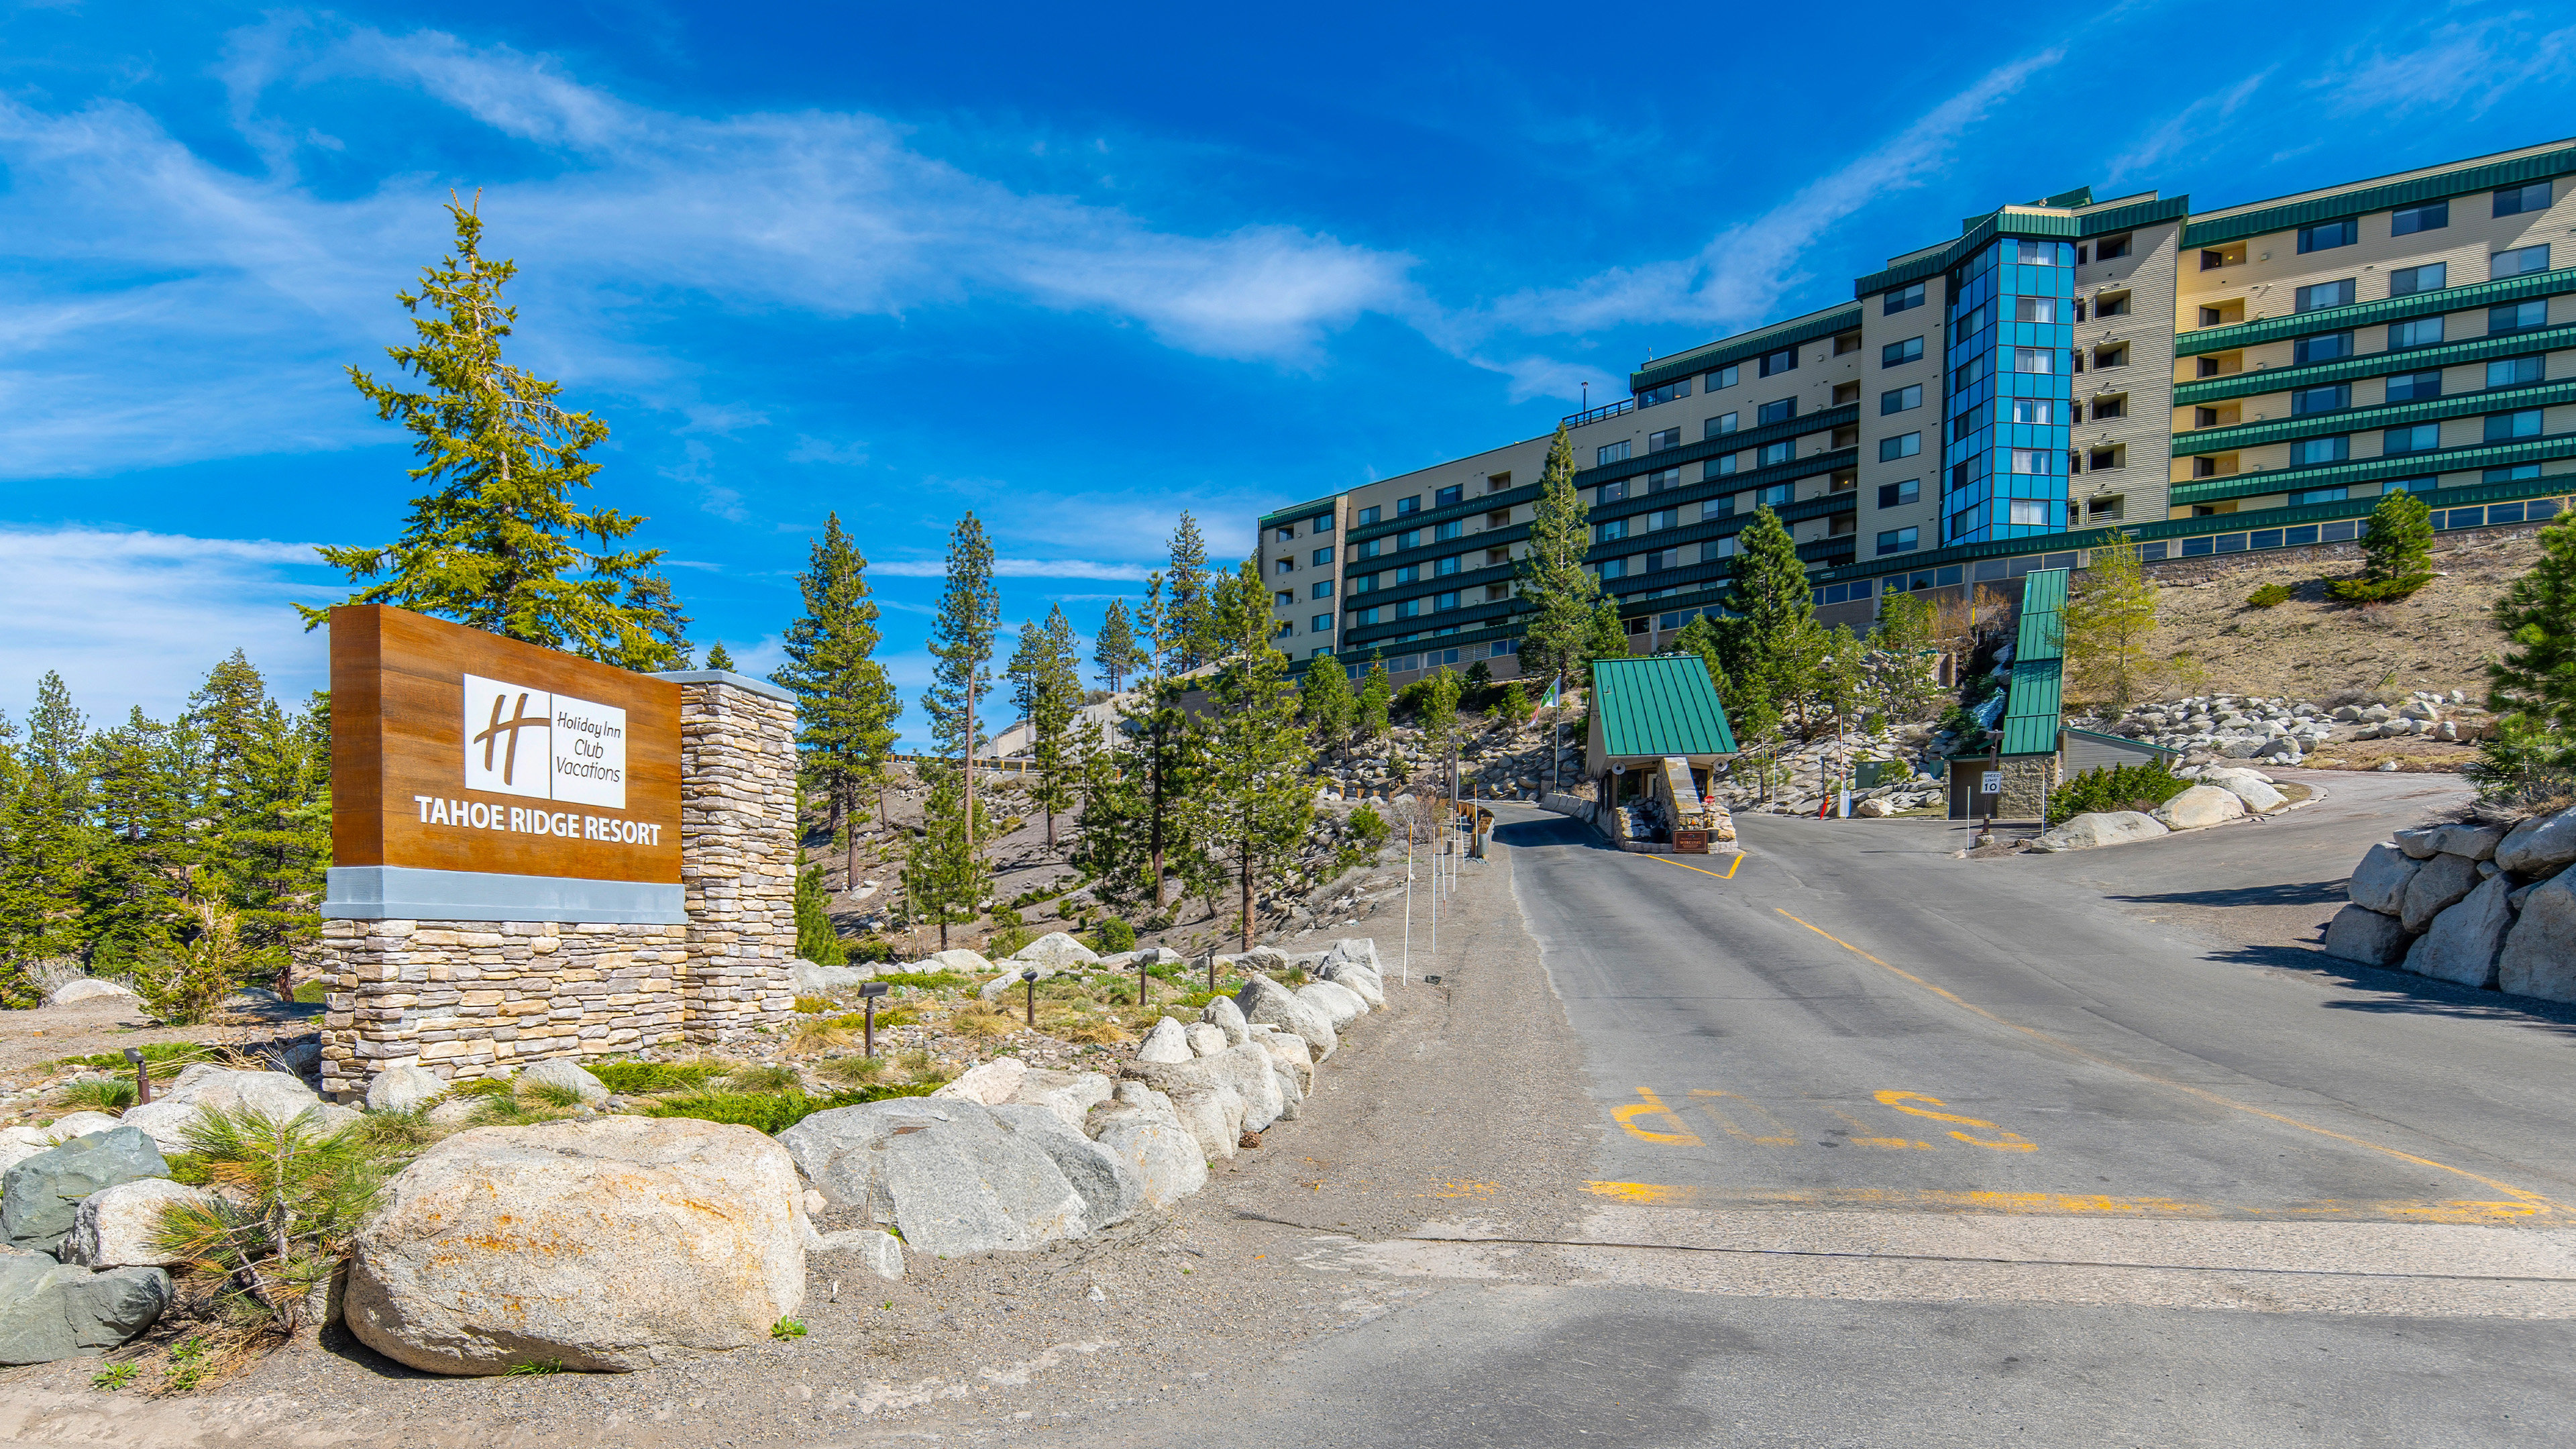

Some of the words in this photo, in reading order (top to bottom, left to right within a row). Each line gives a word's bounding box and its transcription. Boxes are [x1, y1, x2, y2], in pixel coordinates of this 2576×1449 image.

[557, 711, 602, 738] Holiday
[604, 721, 621, 739] Inn
[574, 739, 604, 759] Club
[557, 756, 621, 782] Vacations
[1984, 783, 1997, 791] 10
[414, 795, 505, 831] TAHOE
[511, 807, 580, 839] RIDGE
[584, 816, 661, 847] RESORT
[1610, 1086, 2039, 1152] STOP
